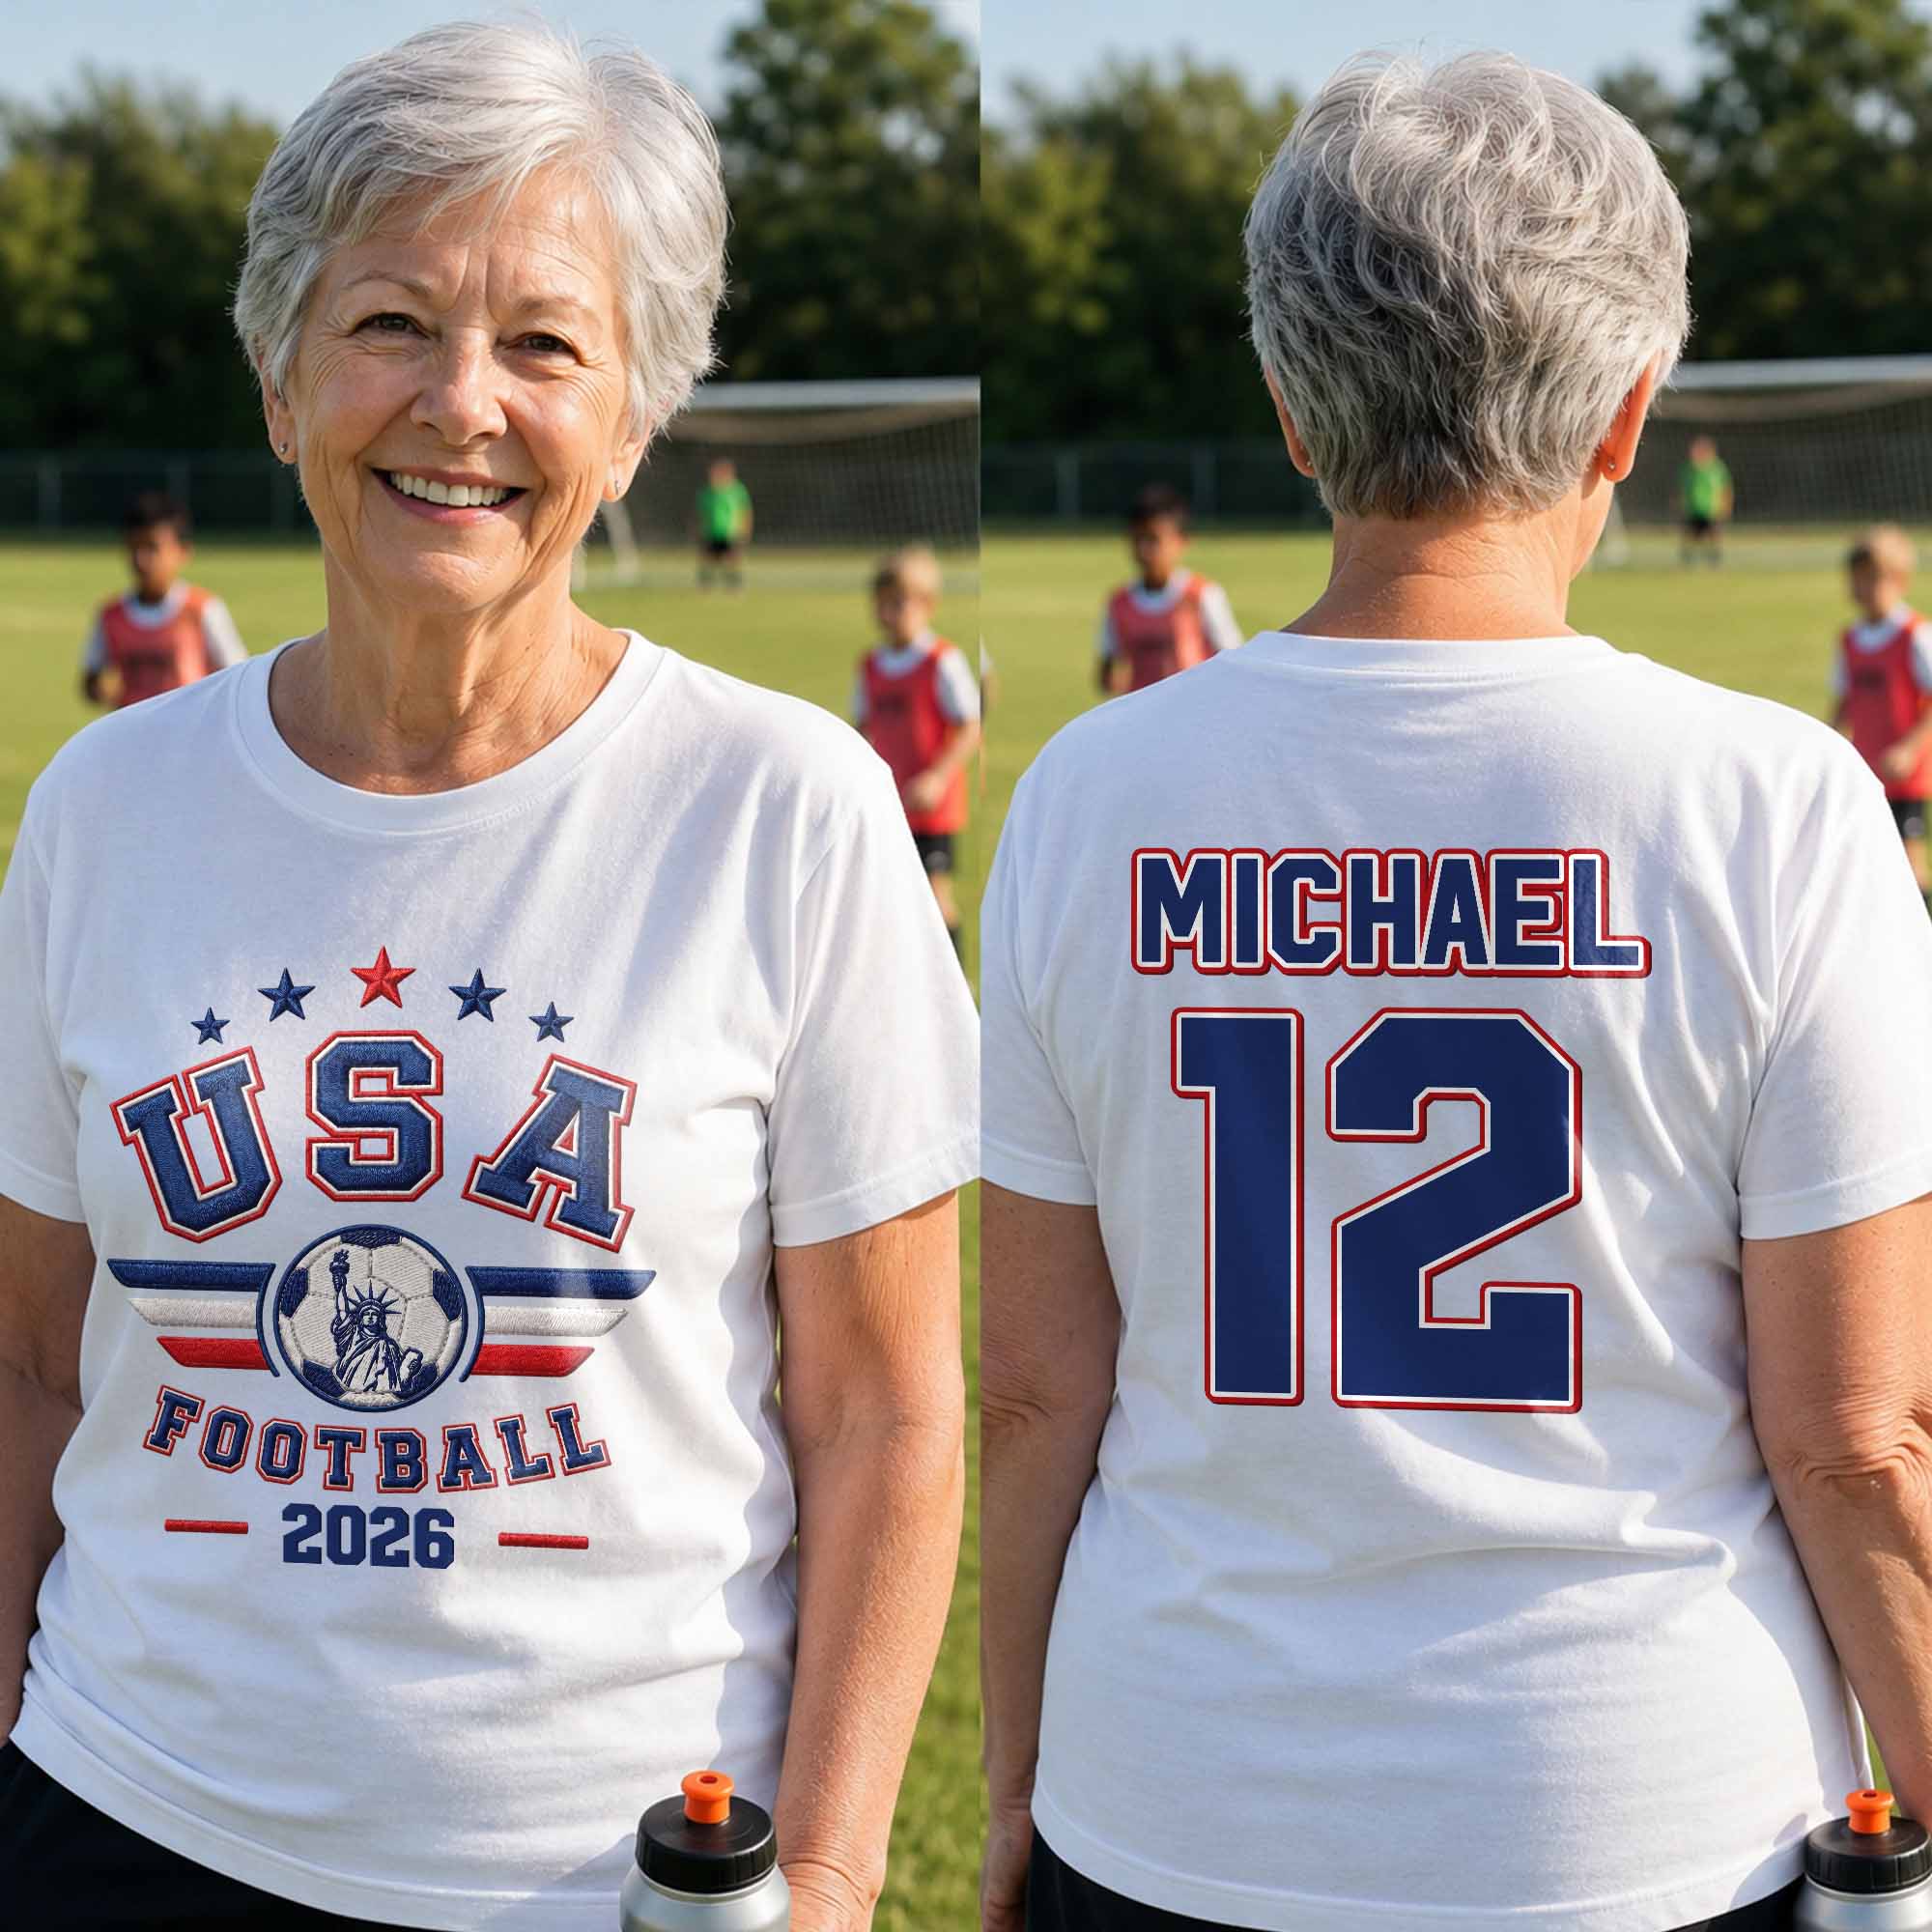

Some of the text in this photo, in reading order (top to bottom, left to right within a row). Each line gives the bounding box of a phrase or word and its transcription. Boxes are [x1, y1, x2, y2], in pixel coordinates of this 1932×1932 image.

[1131, 848, 1652, 979] MICHAEL
[109, 1029, 637, 1253] USA
[1171, 1008, 1582, 1413] 12
[143, 1385, 611, 1494] FOOTBALL
[282, 1502, 455, 1570] 2026
